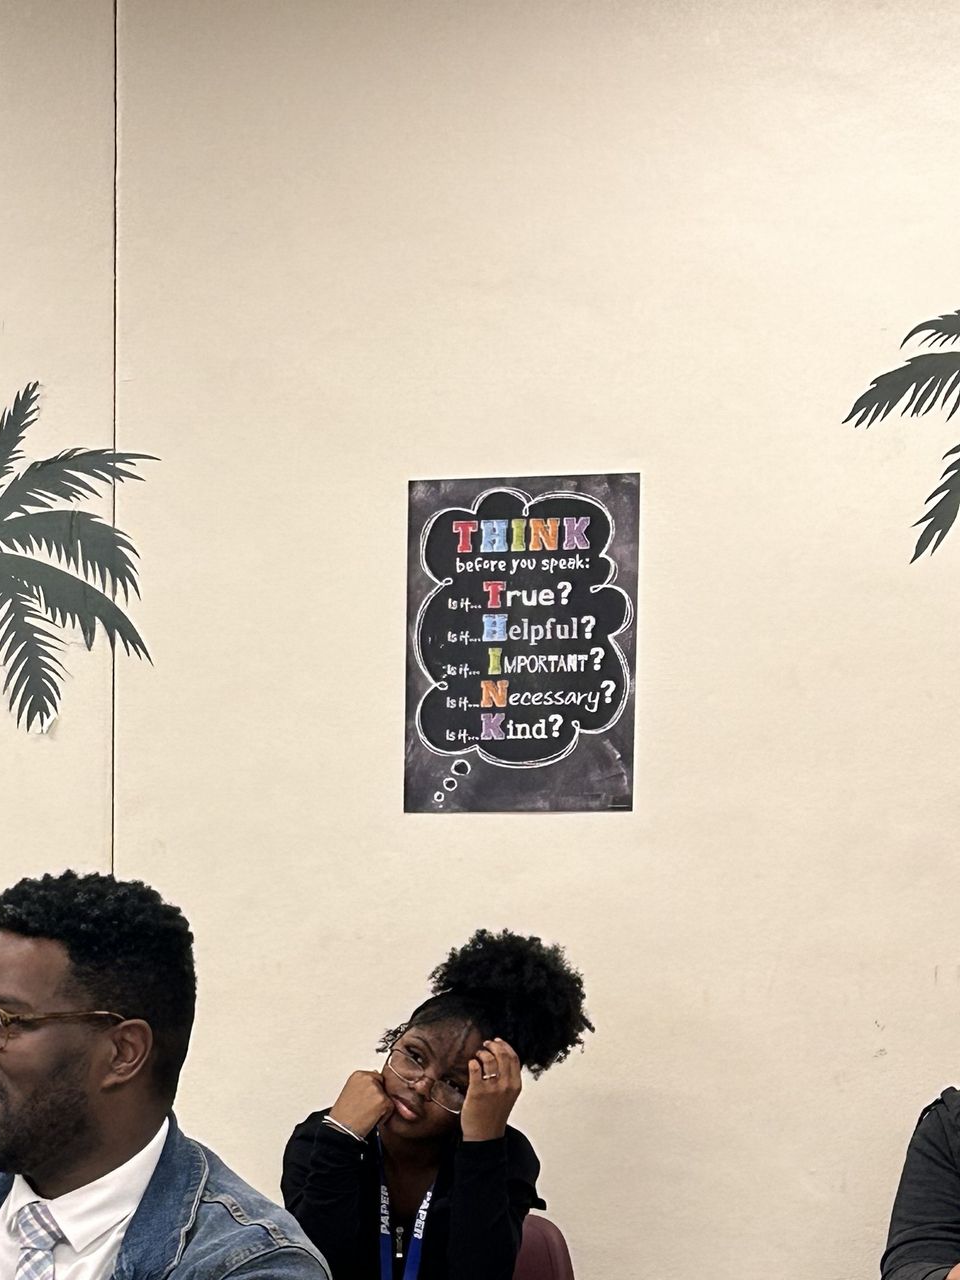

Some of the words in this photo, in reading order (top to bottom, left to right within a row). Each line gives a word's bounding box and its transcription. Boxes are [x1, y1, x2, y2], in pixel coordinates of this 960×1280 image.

[452, 517, 590, 553] THINK
[456, 557, 506, 573] before
[509, 558, 537, 575] you
[541, 554, 590, 574] speak:
[447, 598, 458, 610] Is
[483, 580, 573, 609] True?
[447, 631, 458, 643] Is
[482, 613, 597, 645] Helpful?
[446, 664, 458, 676] Is
[487, 647, 605, 676] IMPORTANT?
[446, 697, 457, 709] Is
[480, 679, 617, 713] Necessary?
[445, 729, 456, 742] Is
[480, 713, 564, 741] Kind?
